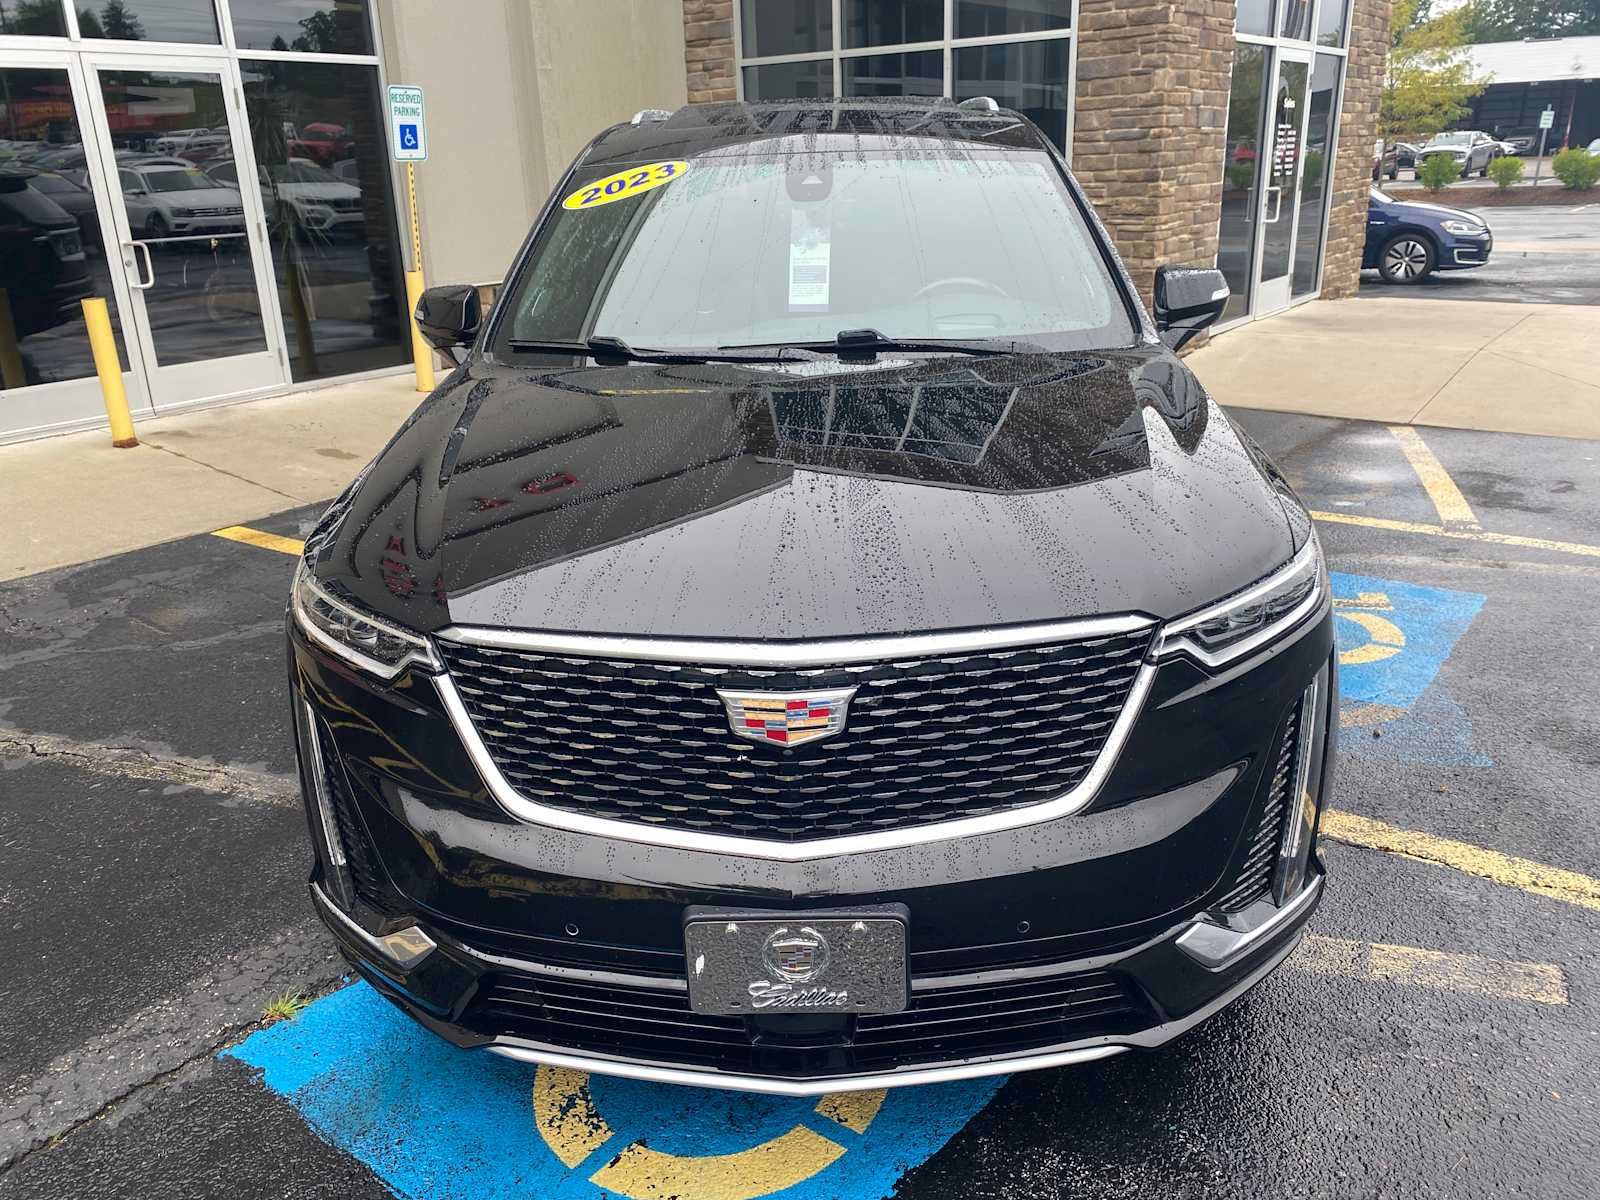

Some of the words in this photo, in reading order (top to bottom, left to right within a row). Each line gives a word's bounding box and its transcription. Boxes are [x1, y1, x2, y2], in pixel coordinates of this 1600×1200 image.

[390, 93, 421, 104] RESERVED
[393, 106, 421, 117] PARKING
[580, 164, 675, 205] 2023
[748, 980, 848, 1008] Cadillac
